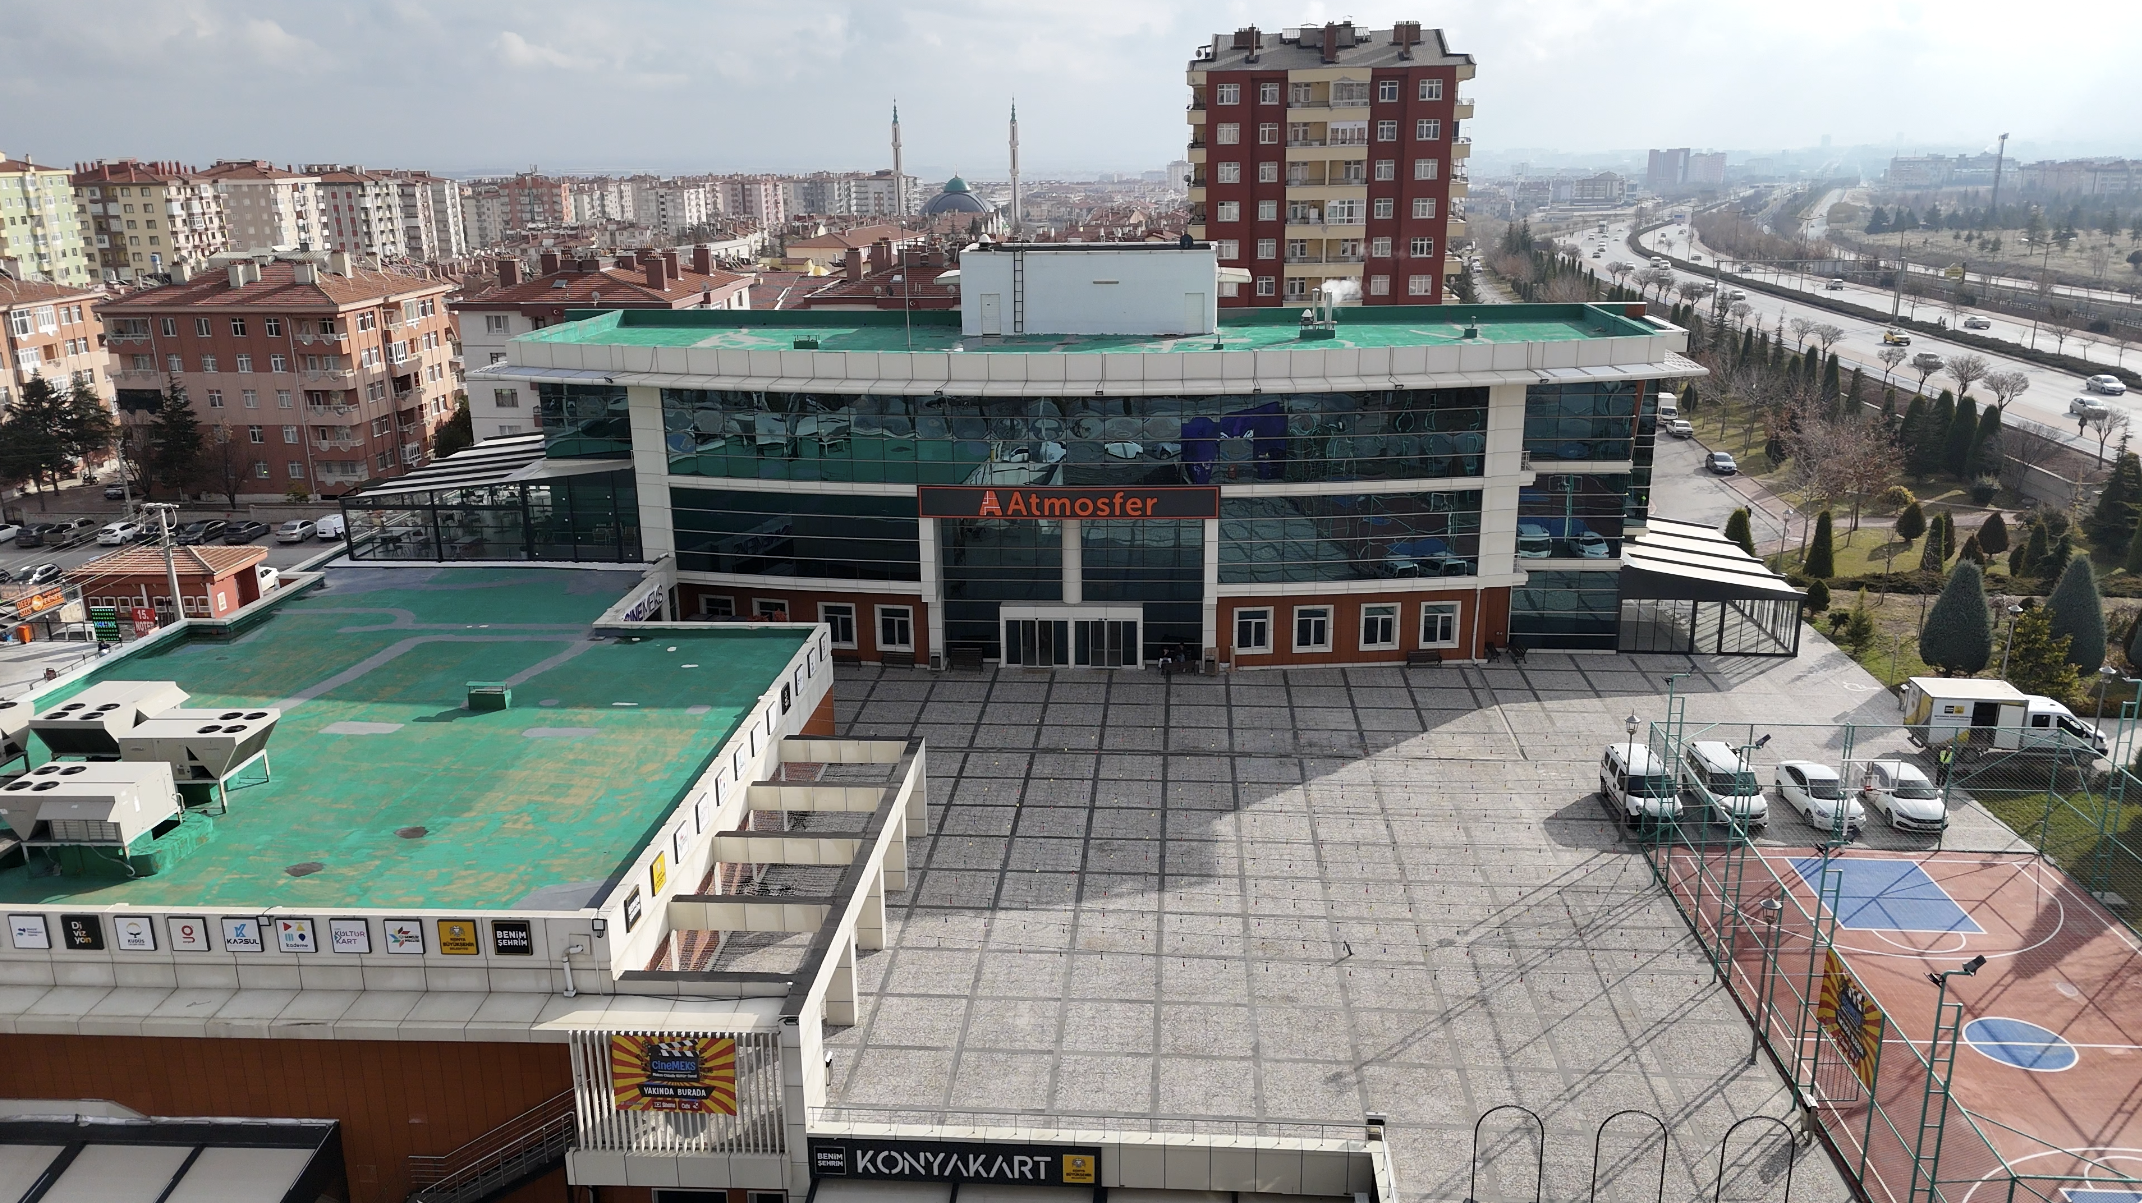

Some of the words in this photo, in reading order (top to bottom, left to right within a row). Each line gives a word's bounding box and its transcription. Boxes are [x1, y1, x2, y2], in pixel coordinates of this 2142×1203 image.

[1007, 490, 1158, 517] Atmosfer
[137, 609, 150, 620] 15.
[651, 1060, 696, 1071] CineMEKS
[643, 1086, 675, 1096] YAKINDA
[677, 1088, 707, 1097] BURADA
[856, 1149, 1052, 1180] KONYAKART
